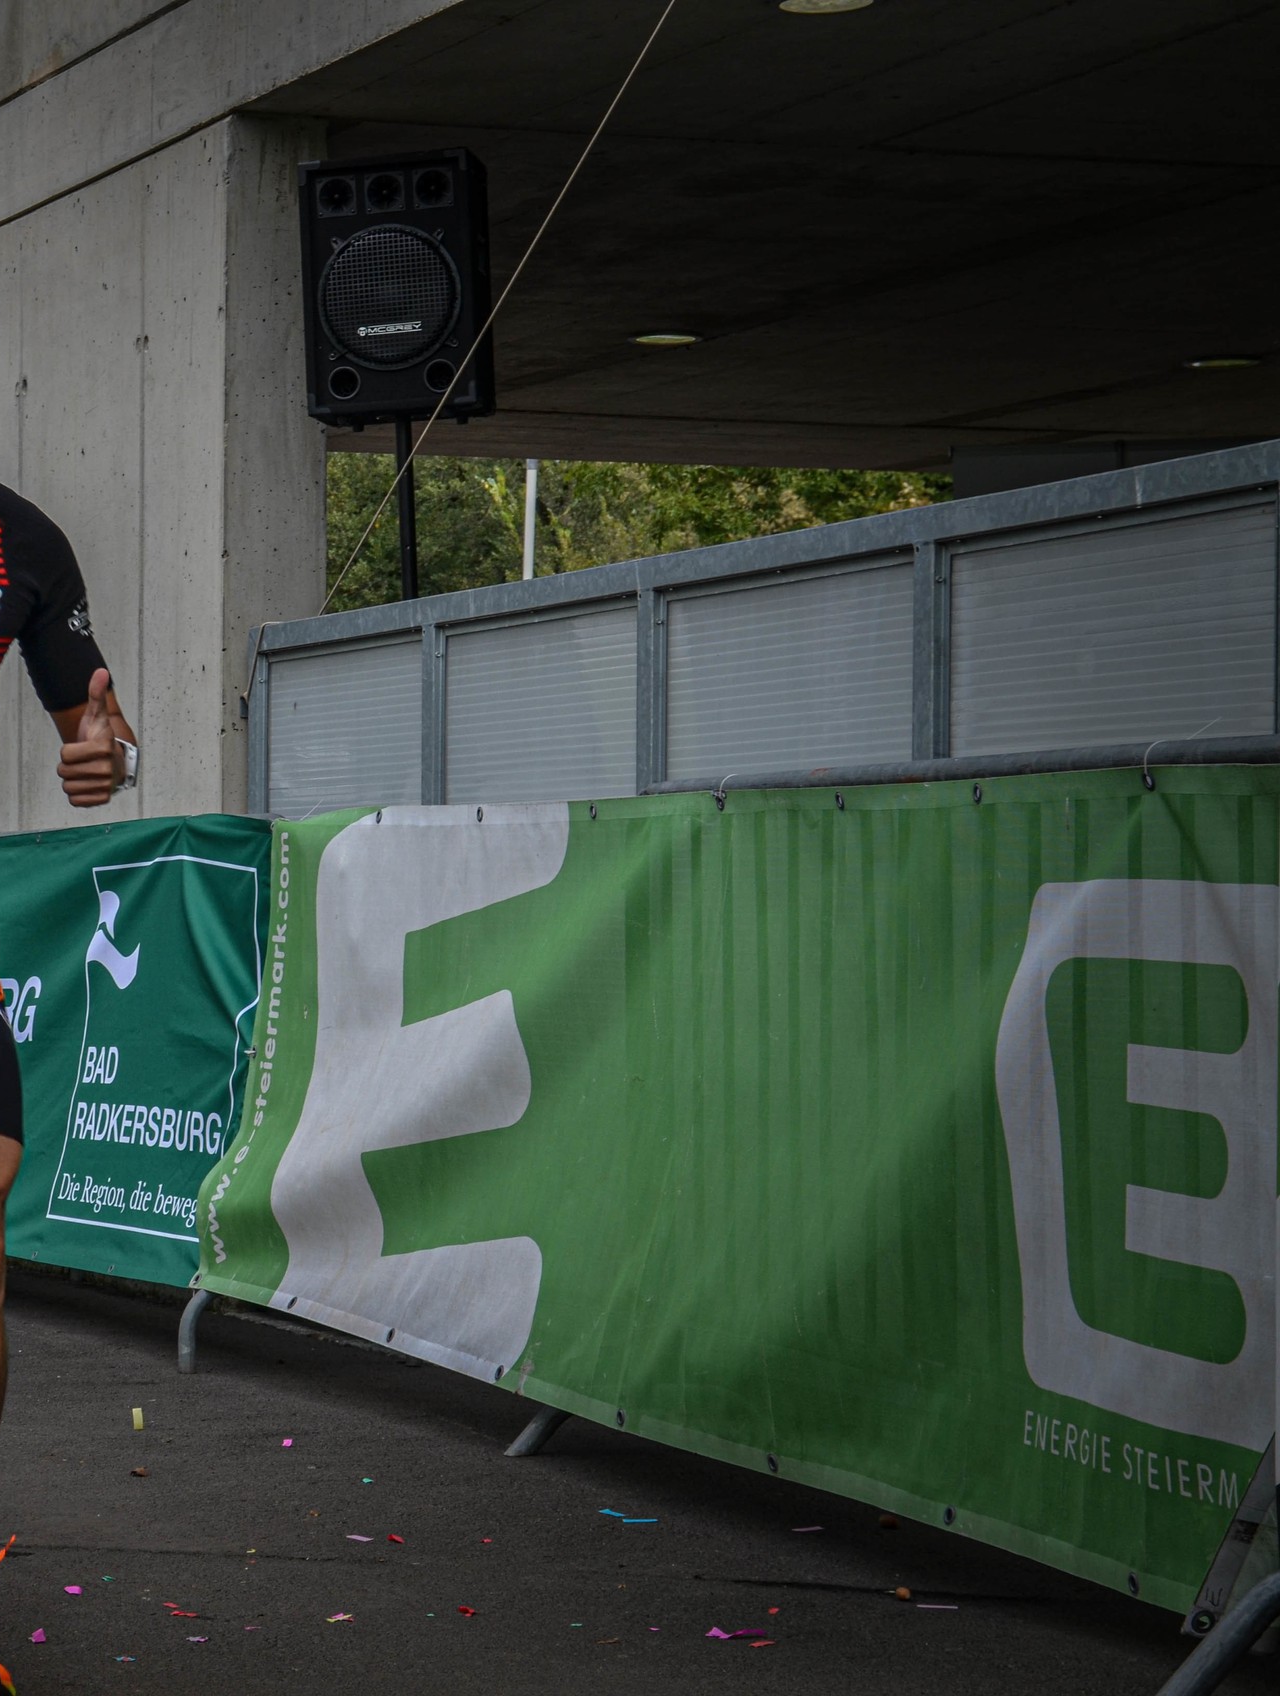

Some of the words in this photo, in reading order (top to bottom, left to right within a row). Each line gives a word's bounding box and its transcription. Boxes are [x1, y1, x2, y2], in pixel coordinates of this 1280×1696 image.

[367, 323, 422, 334] MCGREY
[81, 1045, 119, 1085] BAD
[206, 832, 289, 1265] www.e-steiermark.com
[72, 1101, 222, 1155] RADKERSBURG
[57, 1172, 80, 1201] Die
[79, 1175, 126, 1214] Region,
[129, 1180, 150, 1212] die
[1023, 1409, 1112, 1474] ENERGIE
[1122, 1442, 1251, 1510] STEIERM
